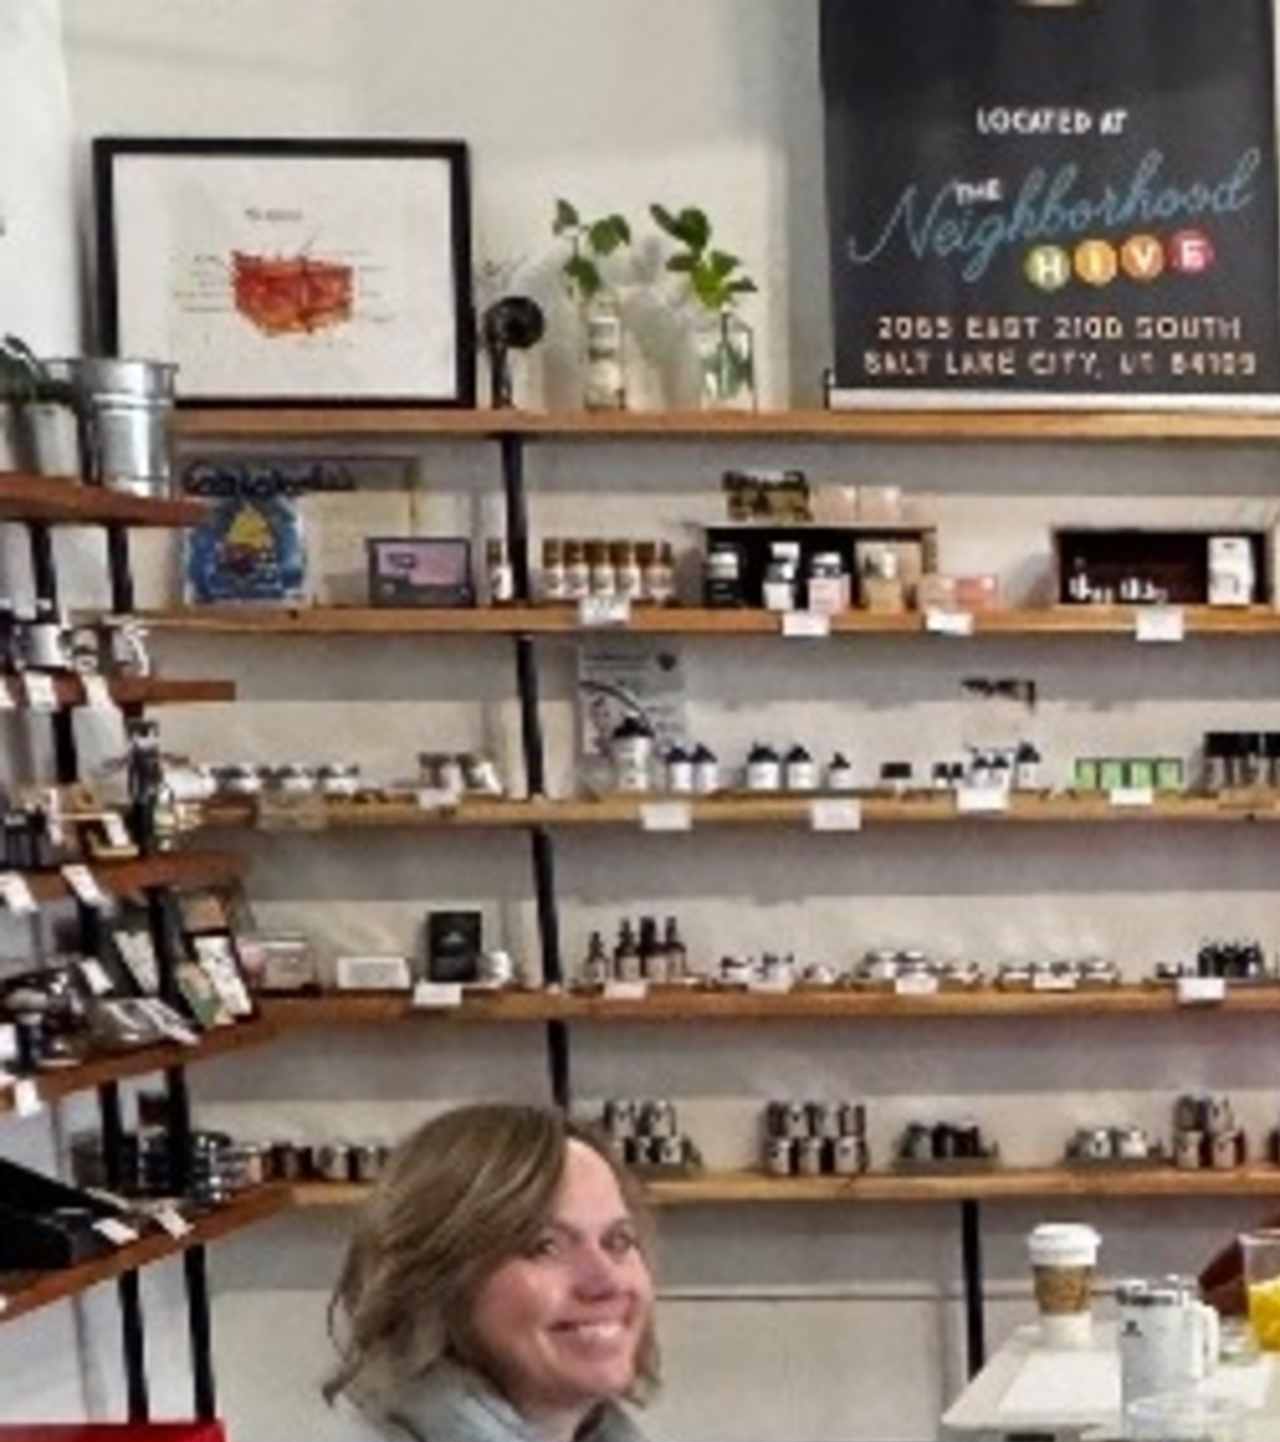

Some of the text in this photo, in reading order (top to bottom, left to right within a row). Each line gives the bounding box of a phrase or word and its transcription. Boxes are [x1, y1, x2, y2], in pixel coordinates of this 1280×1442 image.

[976, 107, 1128, 134] LOCATED AT
[954, 179, 1001, 203] THE
[848, 147, 1261, 282] Neighborhood
[1032, 234, 1212, 284] HIVE
[966, 316, 1039, 340] EAST
[1054, 316, 1124, 340] 2100
[1135, 316, 1241, 340] SOUTH
[863, 352, 930, 376] SALT
[945, 352, 1016, 376] LAKE
